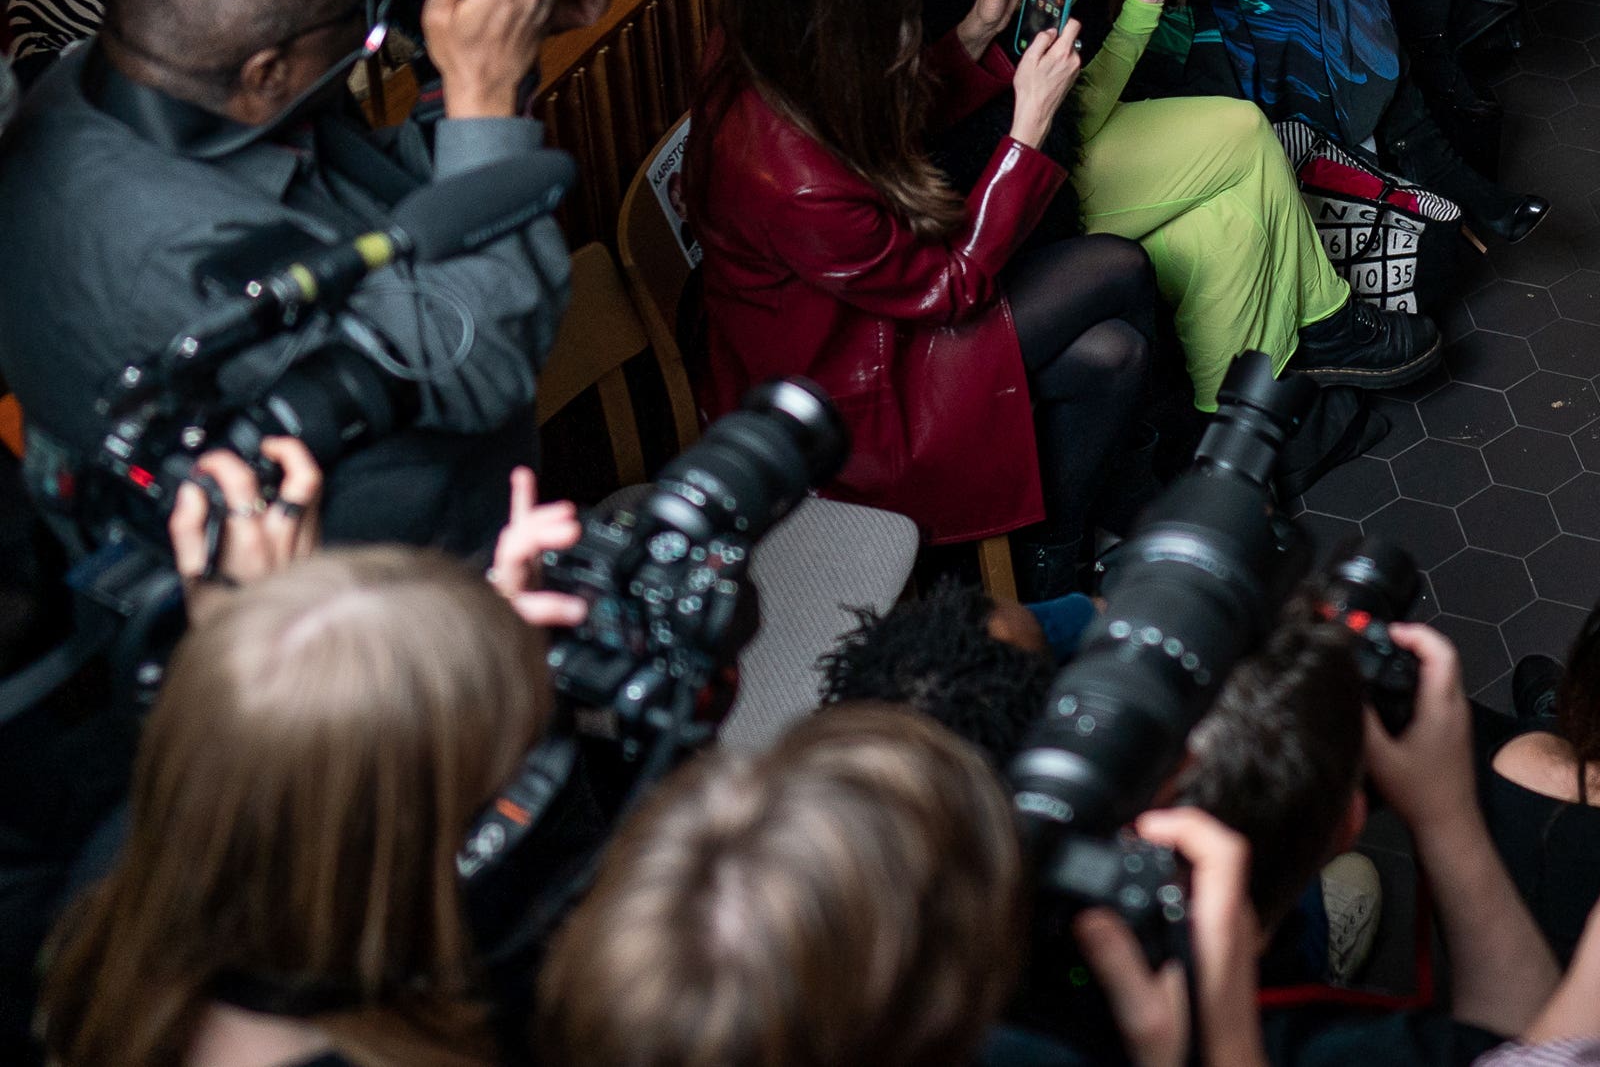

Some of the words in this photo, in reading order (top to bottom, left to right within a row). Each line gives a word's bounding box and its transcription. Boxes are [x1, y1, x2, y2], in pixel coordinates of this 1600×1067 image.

[1393, 232, 1413, 250] 12
[1356, 269, 1378, 289] 10
[1391, 265, 1412, 285] 35
